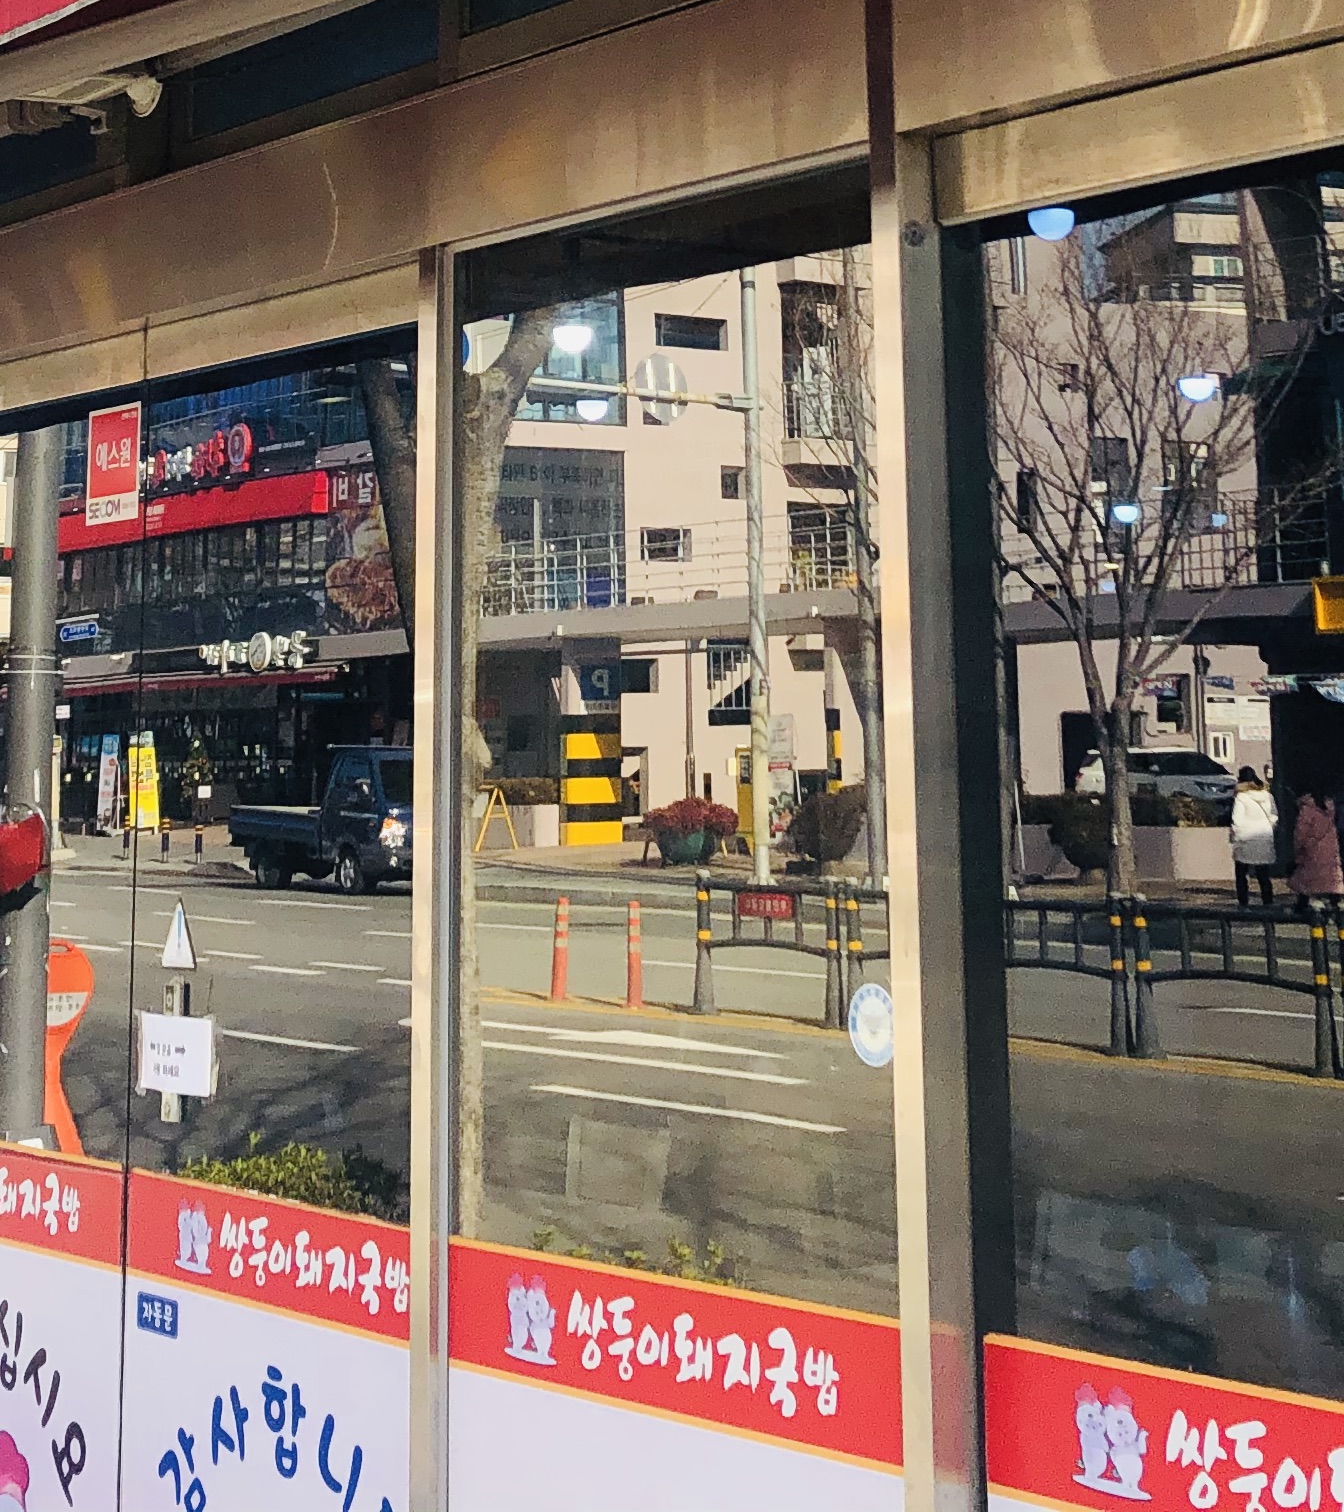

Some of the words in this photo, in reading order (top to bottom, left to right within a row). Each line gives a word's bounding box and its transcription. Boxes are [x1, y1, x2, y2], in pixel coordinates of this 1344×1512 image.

[95, 437, 133, 473] 에스원
[87, 497, 121, 521] SECOM
[142, 1301, 174, 1333] 자동문
[158, 1365, 393, 1512] 감사합니
